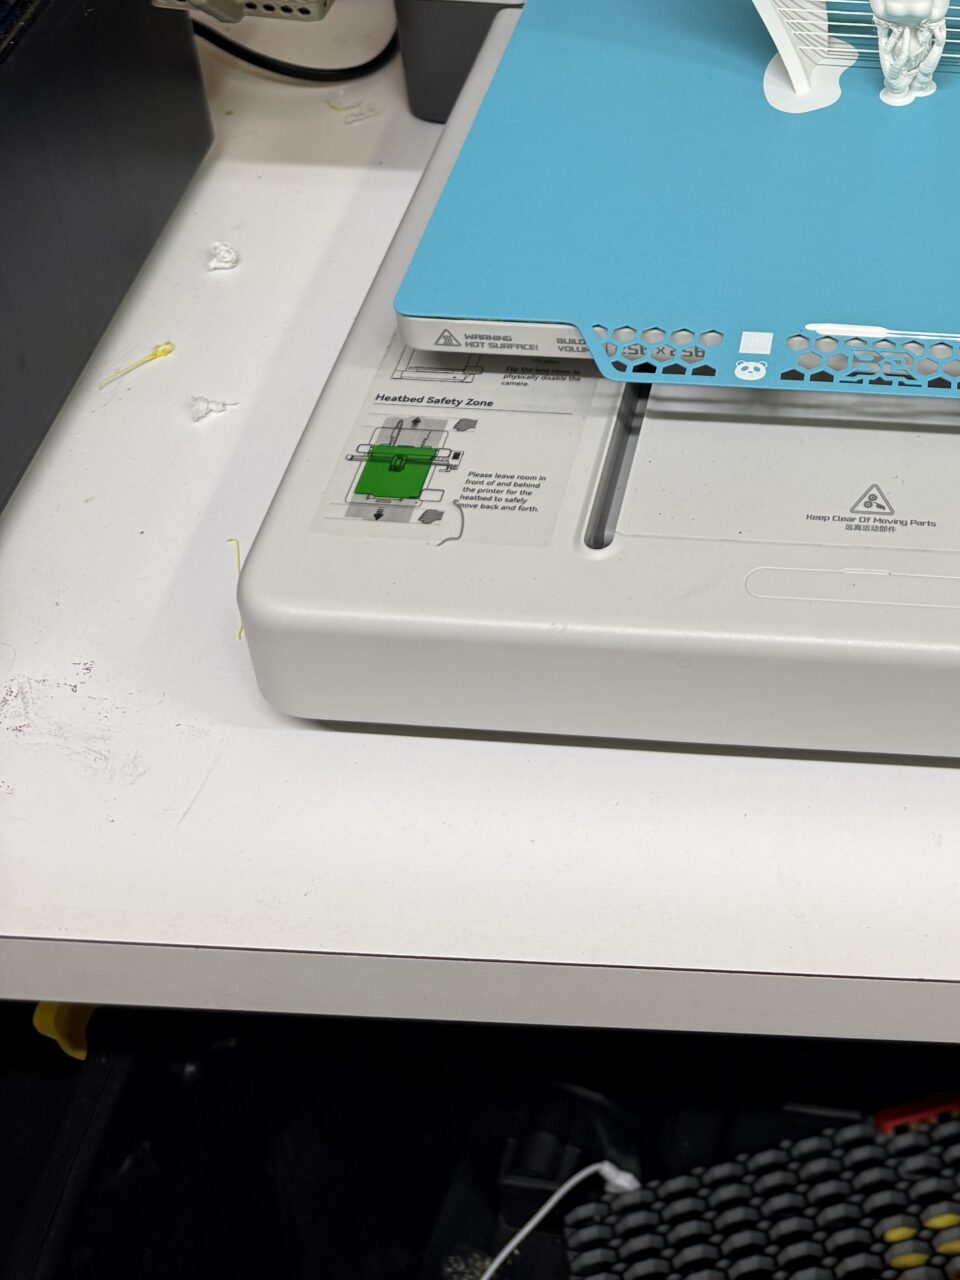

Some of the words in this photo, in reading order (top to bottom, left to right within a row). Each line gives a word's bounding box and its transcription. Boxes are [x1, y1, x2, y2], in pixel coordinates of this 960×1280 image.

[464, 333, 513, 342] WARNING
[556, 337, 586, 345] BUILD
[488, 342, 539, 351] SURFACE!
[503, 373, 540, 381] physically
[374, 393, 424, 404] Heatbed
[426, 395, 463, 407] Safety
[465, 398, 495, 408] Zone
[468, 470, 493, 479] Please
[494, 472, 515, 480] leave
[465, 478, 485, 486] front
[513, 480, 541, 489] behind
[476, 487, 504, 495] printer
[459, 494, 493, 502] heatbed
[504, 496, 528, 505] safely
[480, 502, 500, 510] back
[517, 505, 539, 513] forth.
[805, 513, 830, 522] Keep
[831, 514, 857, 523] Clear
[858, 515, 872, 524] Of
[873, 516, 908, 527] Moving
[909, 519, 937, 528] Parts
